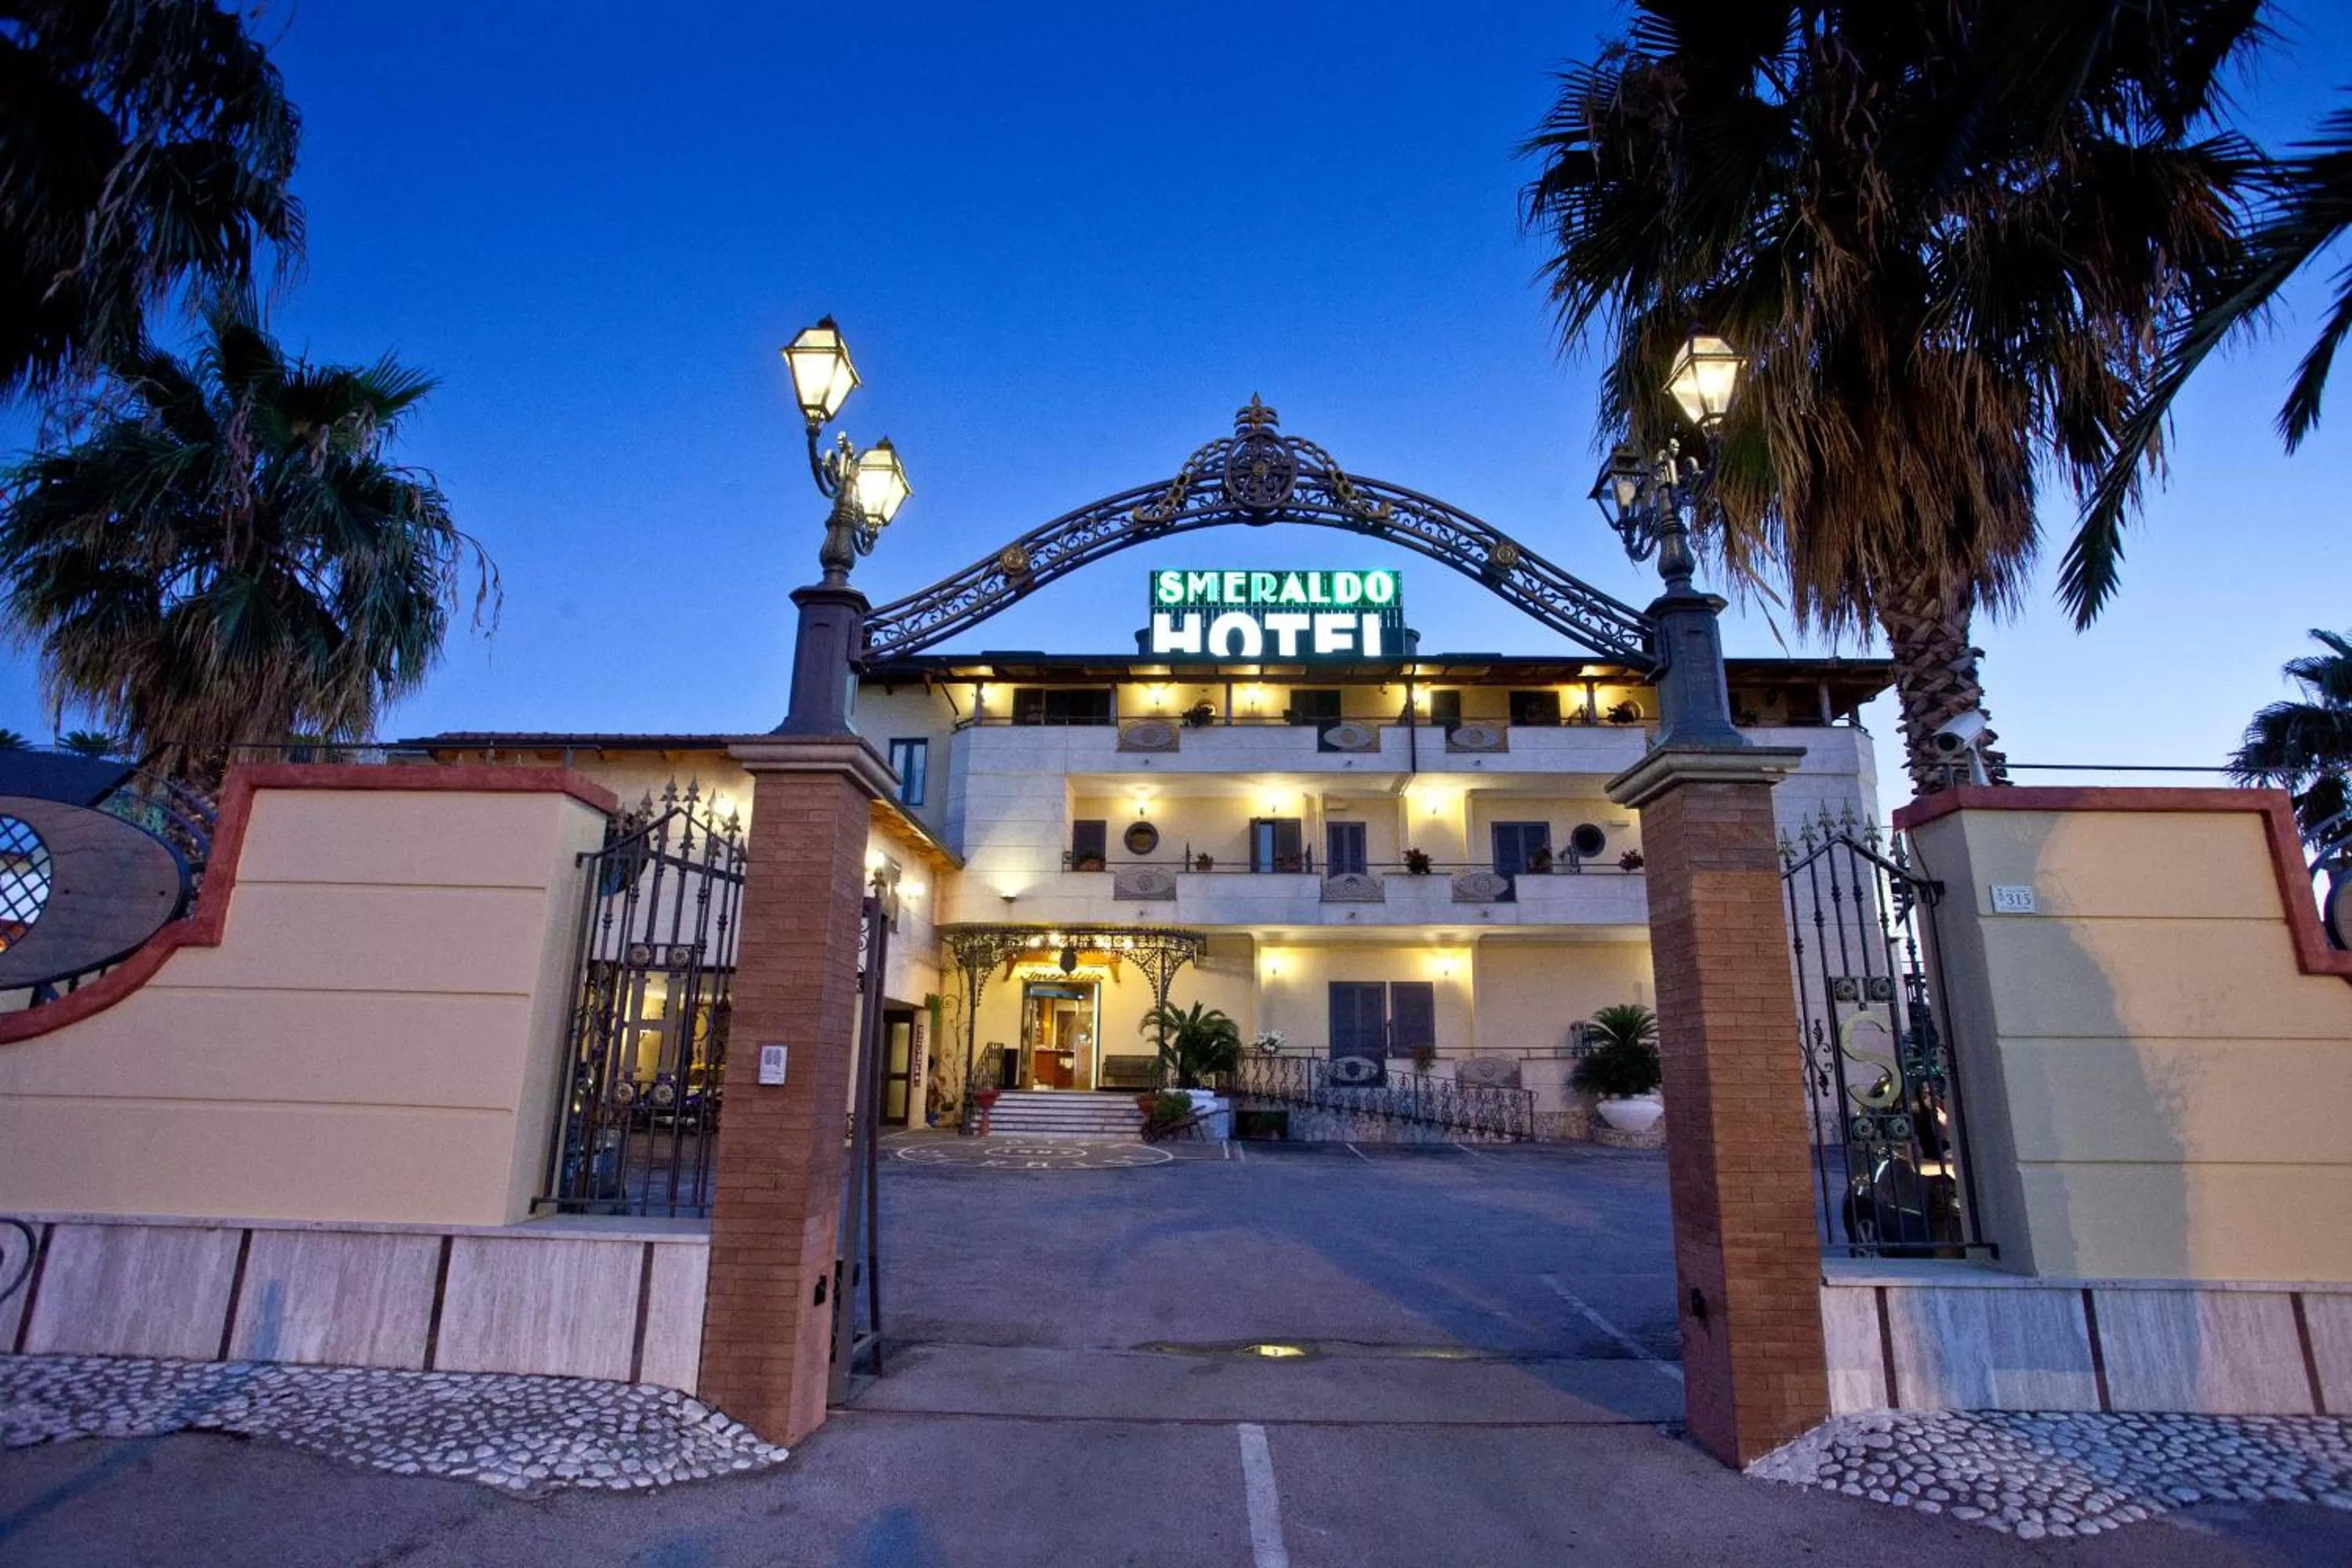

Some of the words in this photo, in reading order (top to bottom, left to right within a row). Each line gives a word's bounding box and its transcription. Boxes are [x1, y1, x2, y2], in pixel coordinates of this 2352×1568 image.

[1158, 571, 1394, 603] SMERALDO
[2006, 892, 2031, 905] 315
[1839, 1010, 1903, 1109] S
